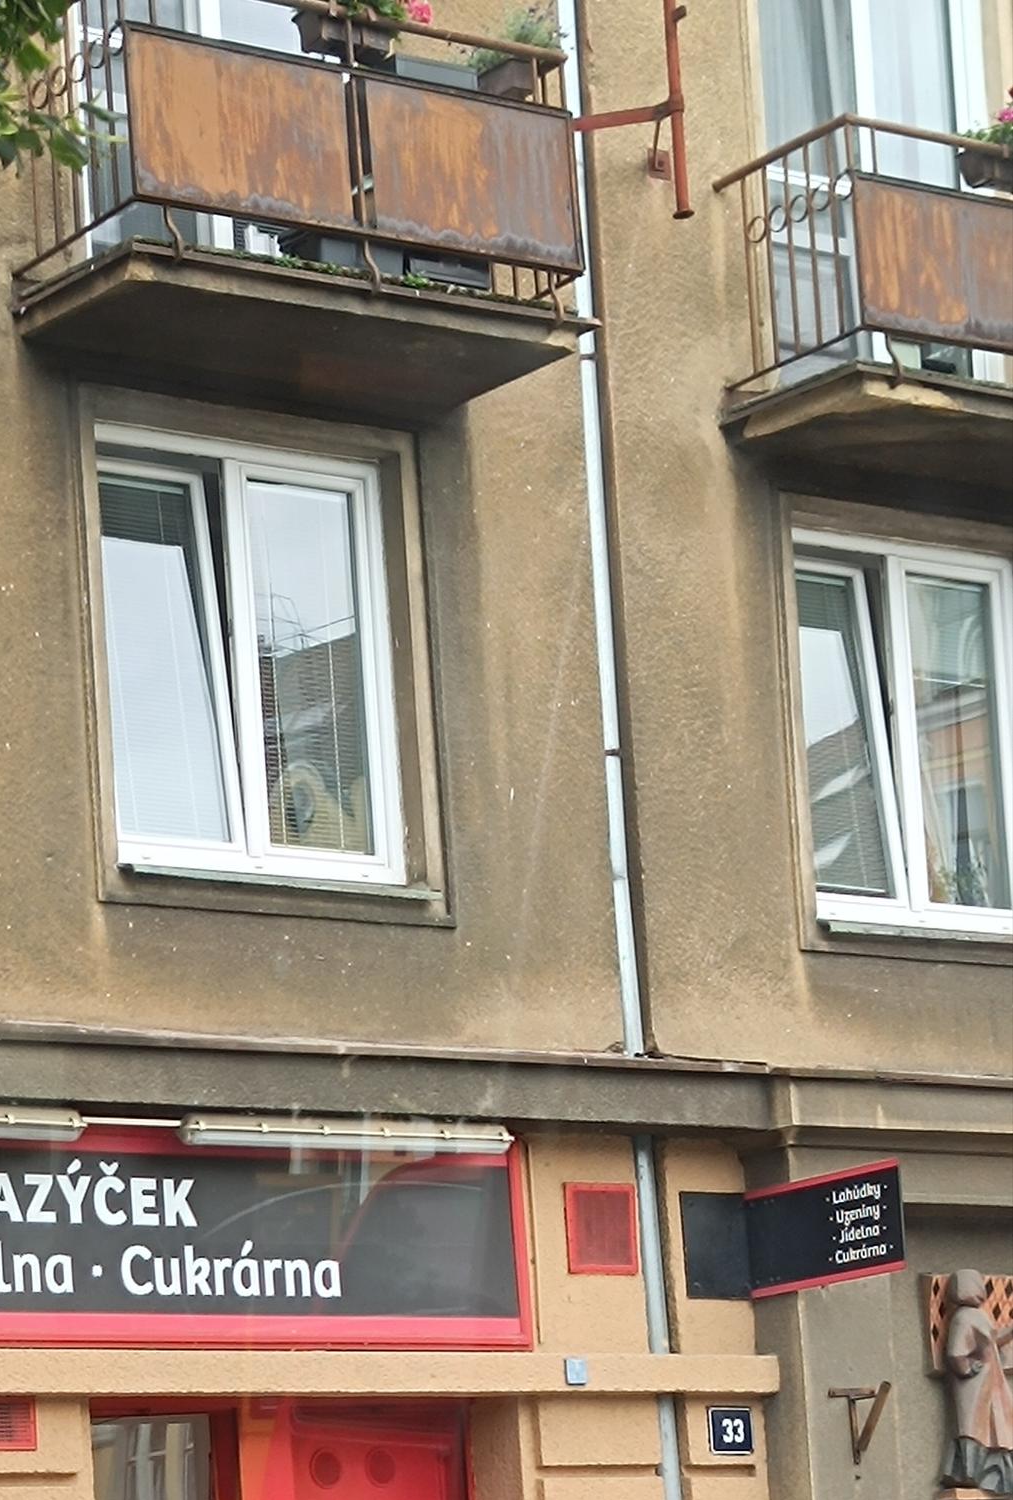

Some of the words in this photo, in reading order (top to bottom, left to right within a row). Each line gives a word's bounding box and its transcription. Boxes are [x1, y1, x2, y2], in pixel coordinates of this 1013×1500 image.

[836, 1204, 881, 1226] Uzeniny
[839, 1225, 880, 1244] Jídelna
[120, 1240, 343, 1299] Cukrárna
[721, 1418, 746, 1444] 33
